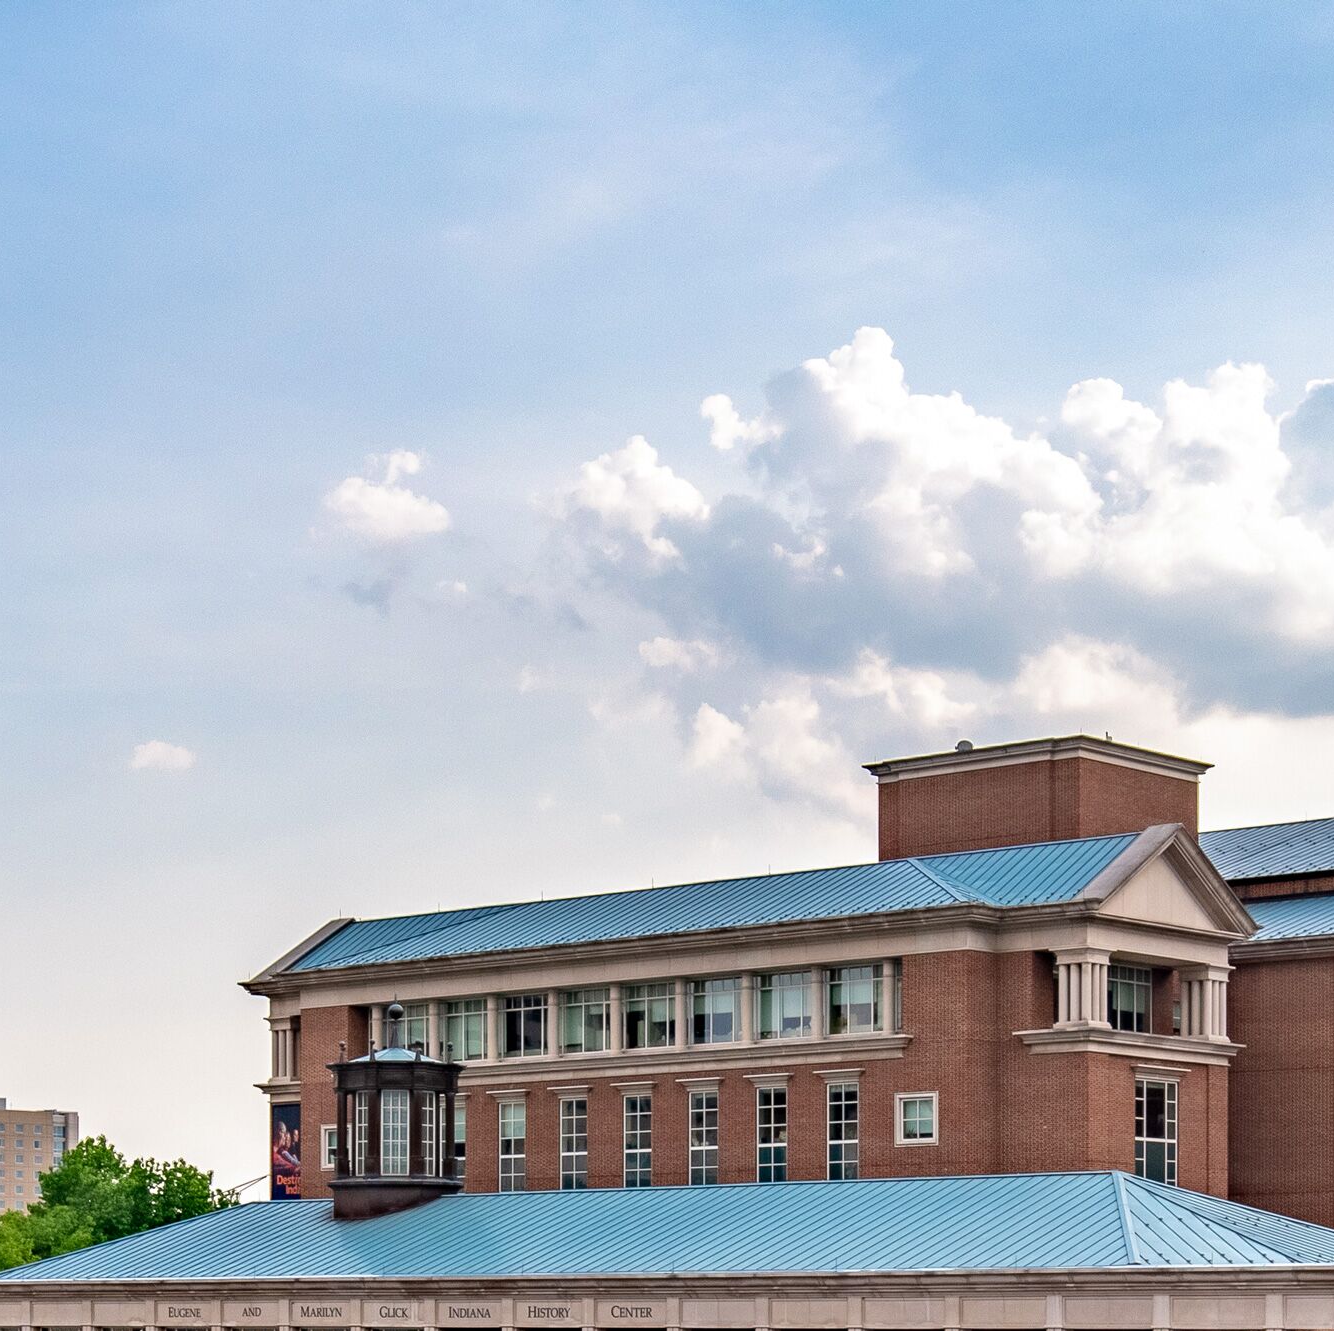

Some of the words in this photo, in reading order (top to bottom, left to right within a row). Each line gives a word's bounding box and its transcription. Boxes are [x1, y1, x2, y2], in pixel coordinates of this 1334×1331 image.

[168, 1307, 201, 1318] EUGENE
[242, 1307, 262, 1317] AND
[300, 1306, 342, 1318] MARILYN
[379, 1306, 408, 1319] GLICK
[448, 1306, 491, 1319] INDIANA
[527, 1306, 570, 1319] HISTORY
[611, 1305, 652, 1319] CENTER
